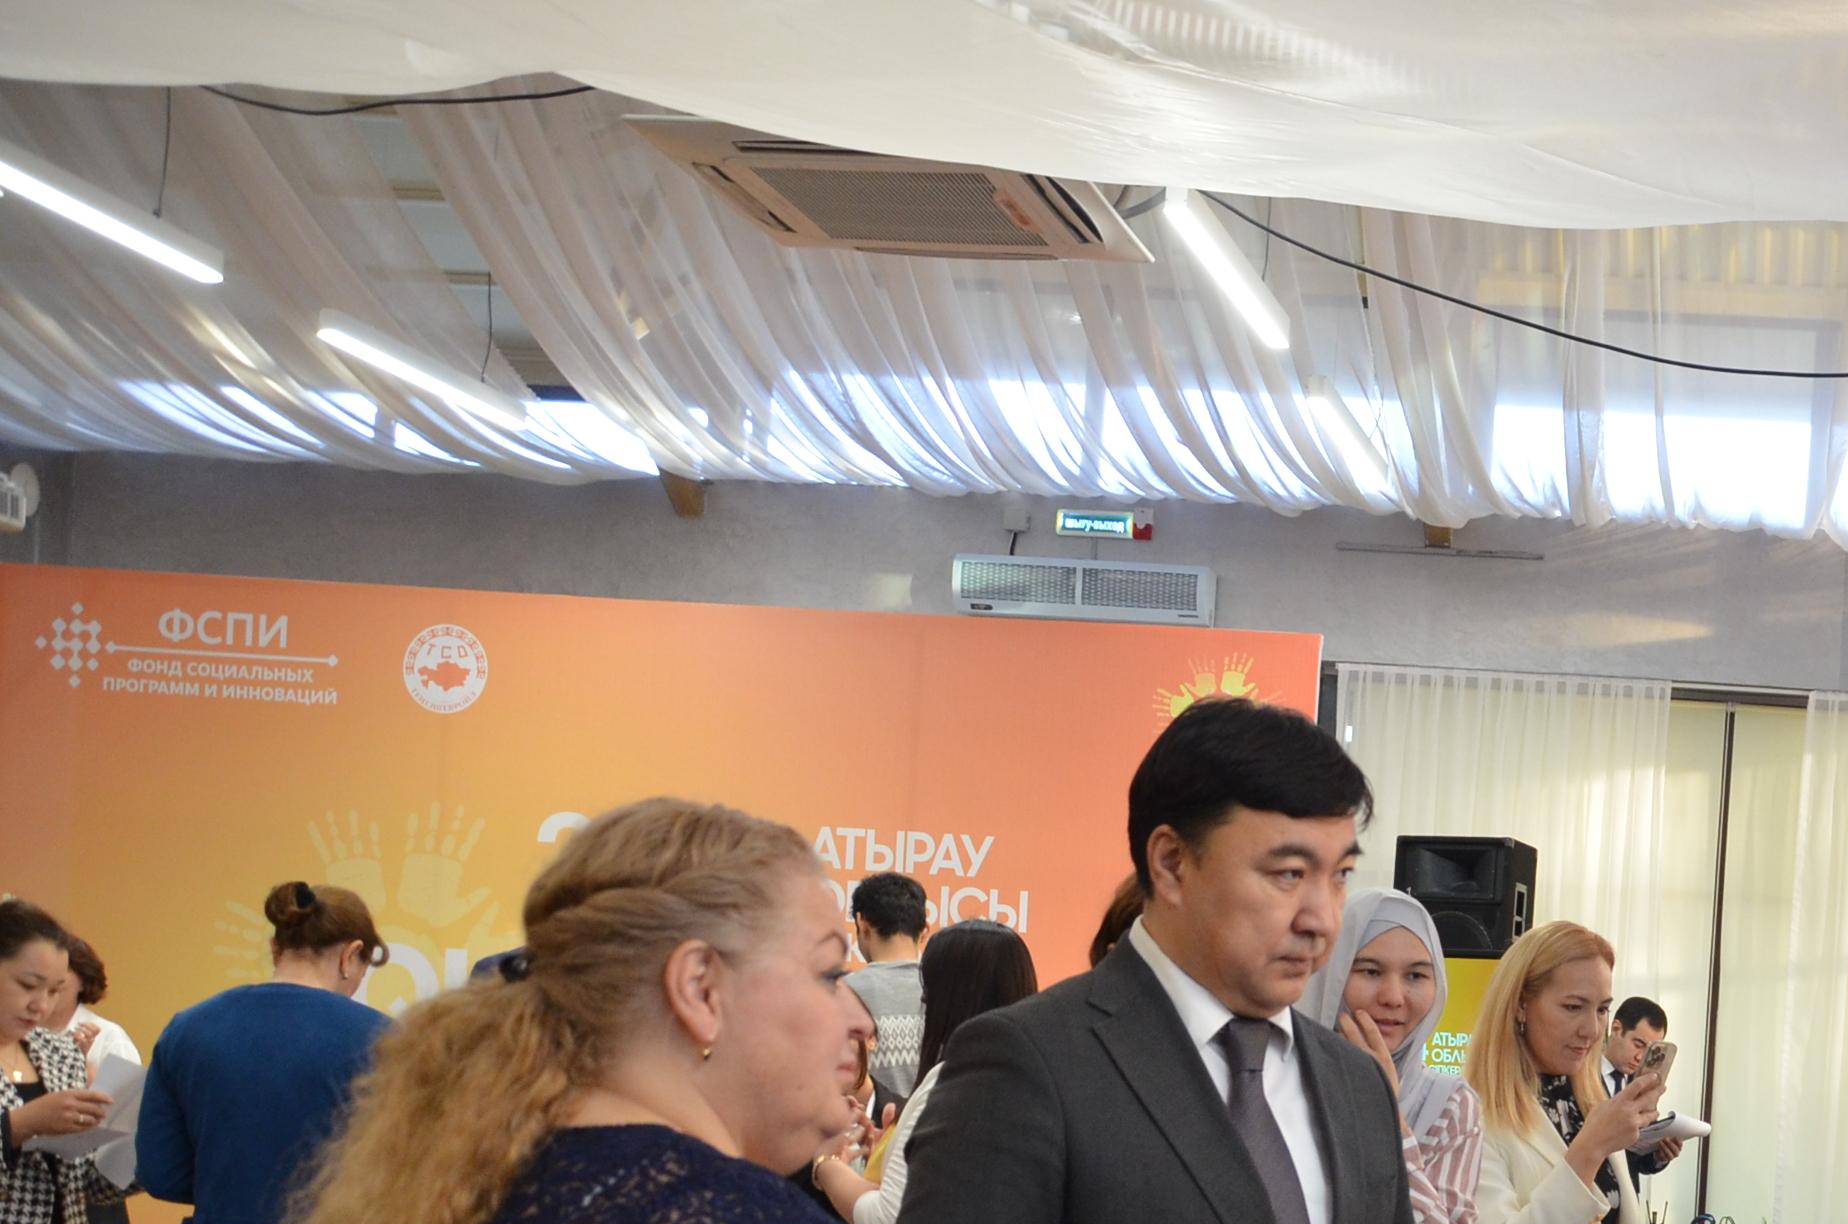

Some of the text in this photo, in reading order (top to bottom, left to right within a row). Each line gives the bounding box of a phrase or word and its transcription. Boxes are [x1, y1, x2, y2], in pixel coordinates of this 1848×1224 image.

[158, 608, 289, 648] ФСПИ
[127, 658, 314, 683] ФОНД СОЦИАЛЬНЫХ
[102, 677, 338, 705] ПРОГРАММ И ИННОВАЦИЙ
[812, 826, 995, 878] АТЫРАУ
[1432, 1031, 1472, 1047] АТЫР
